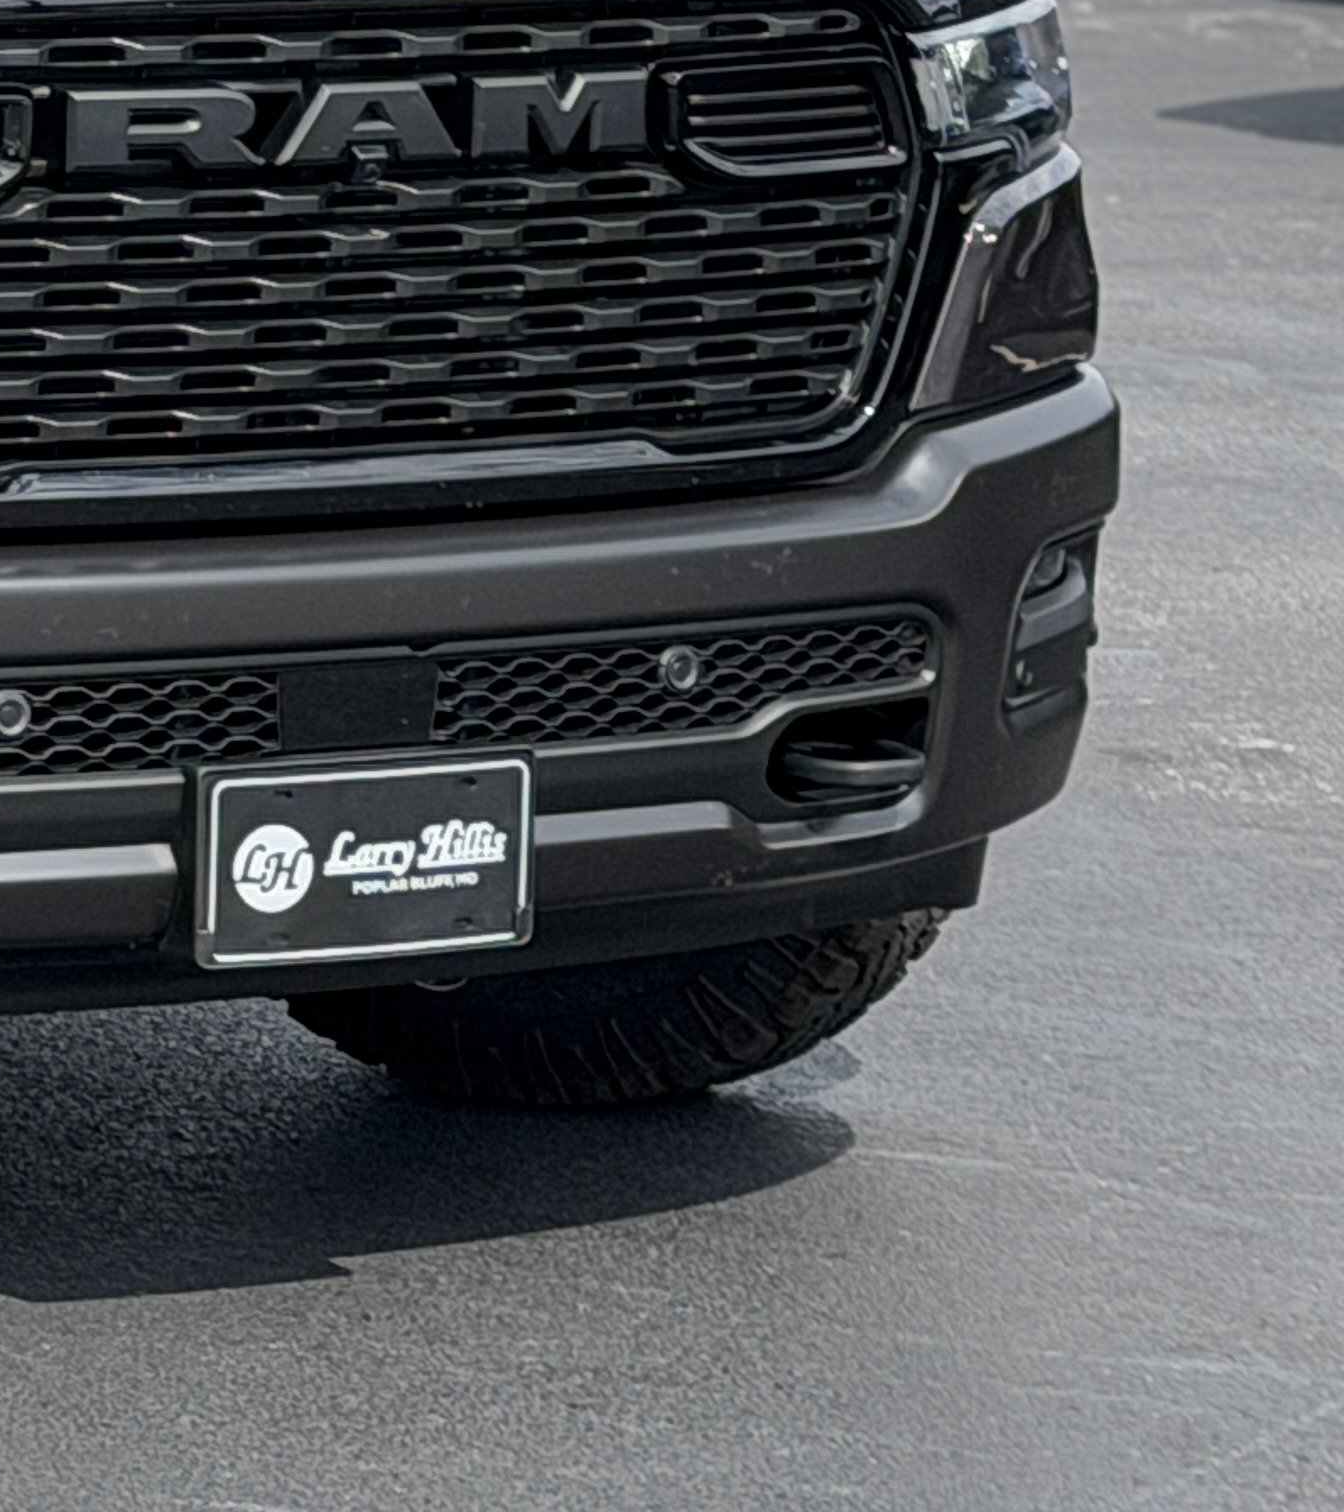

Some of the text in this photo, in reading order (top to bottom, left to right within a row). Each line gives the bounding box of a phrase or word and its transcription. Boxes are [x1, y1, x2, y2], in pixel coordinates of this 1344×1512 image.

[66, 71, 650, 169] RAM
[323, 819, 508, 876] Larry Hillis
